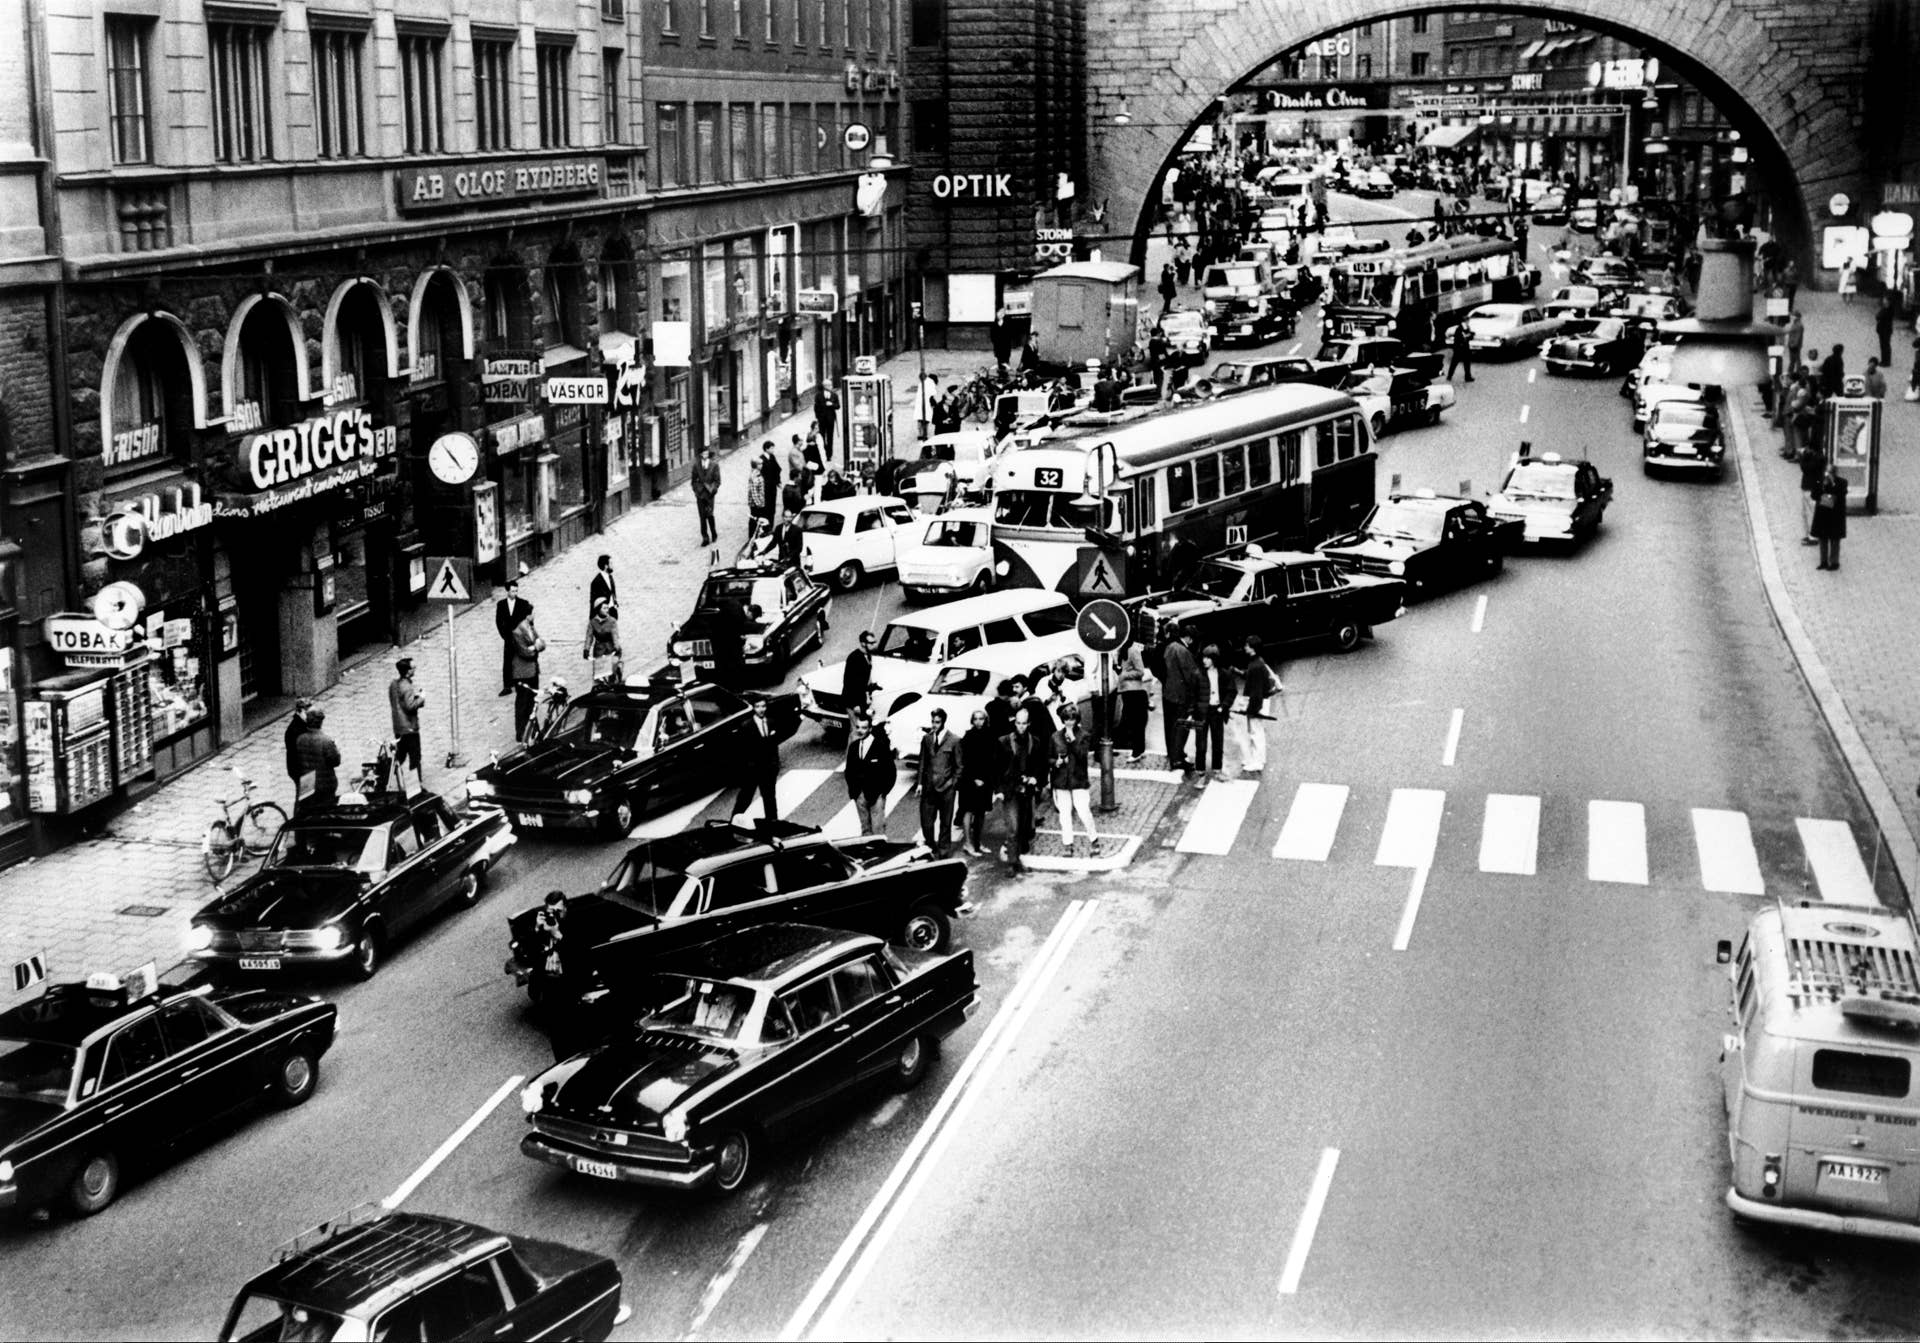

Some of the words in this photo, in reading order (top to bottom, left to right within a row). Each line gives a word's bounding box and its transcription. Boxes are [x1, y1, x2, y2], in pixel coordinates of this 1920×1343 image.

[1305, 38, 1350, 56] AEG
[413, 174, 444, 200] AB
[455, 170, 505, 197] OLOF
[515, 163, 598, 191] RYDBERG
[933, 174, 1012, 198] OPTIK
[1036, 229, 1073, 241] STORM
[550, 380, 604, 399] VÄSKOR
[250, 408, 373, 489] GRIGG'S
[1040, 471, 1059, 485] 32
[54, 630, 121, 648] TOBAK
[1829, 1163, 1881, 1180] AA1922
